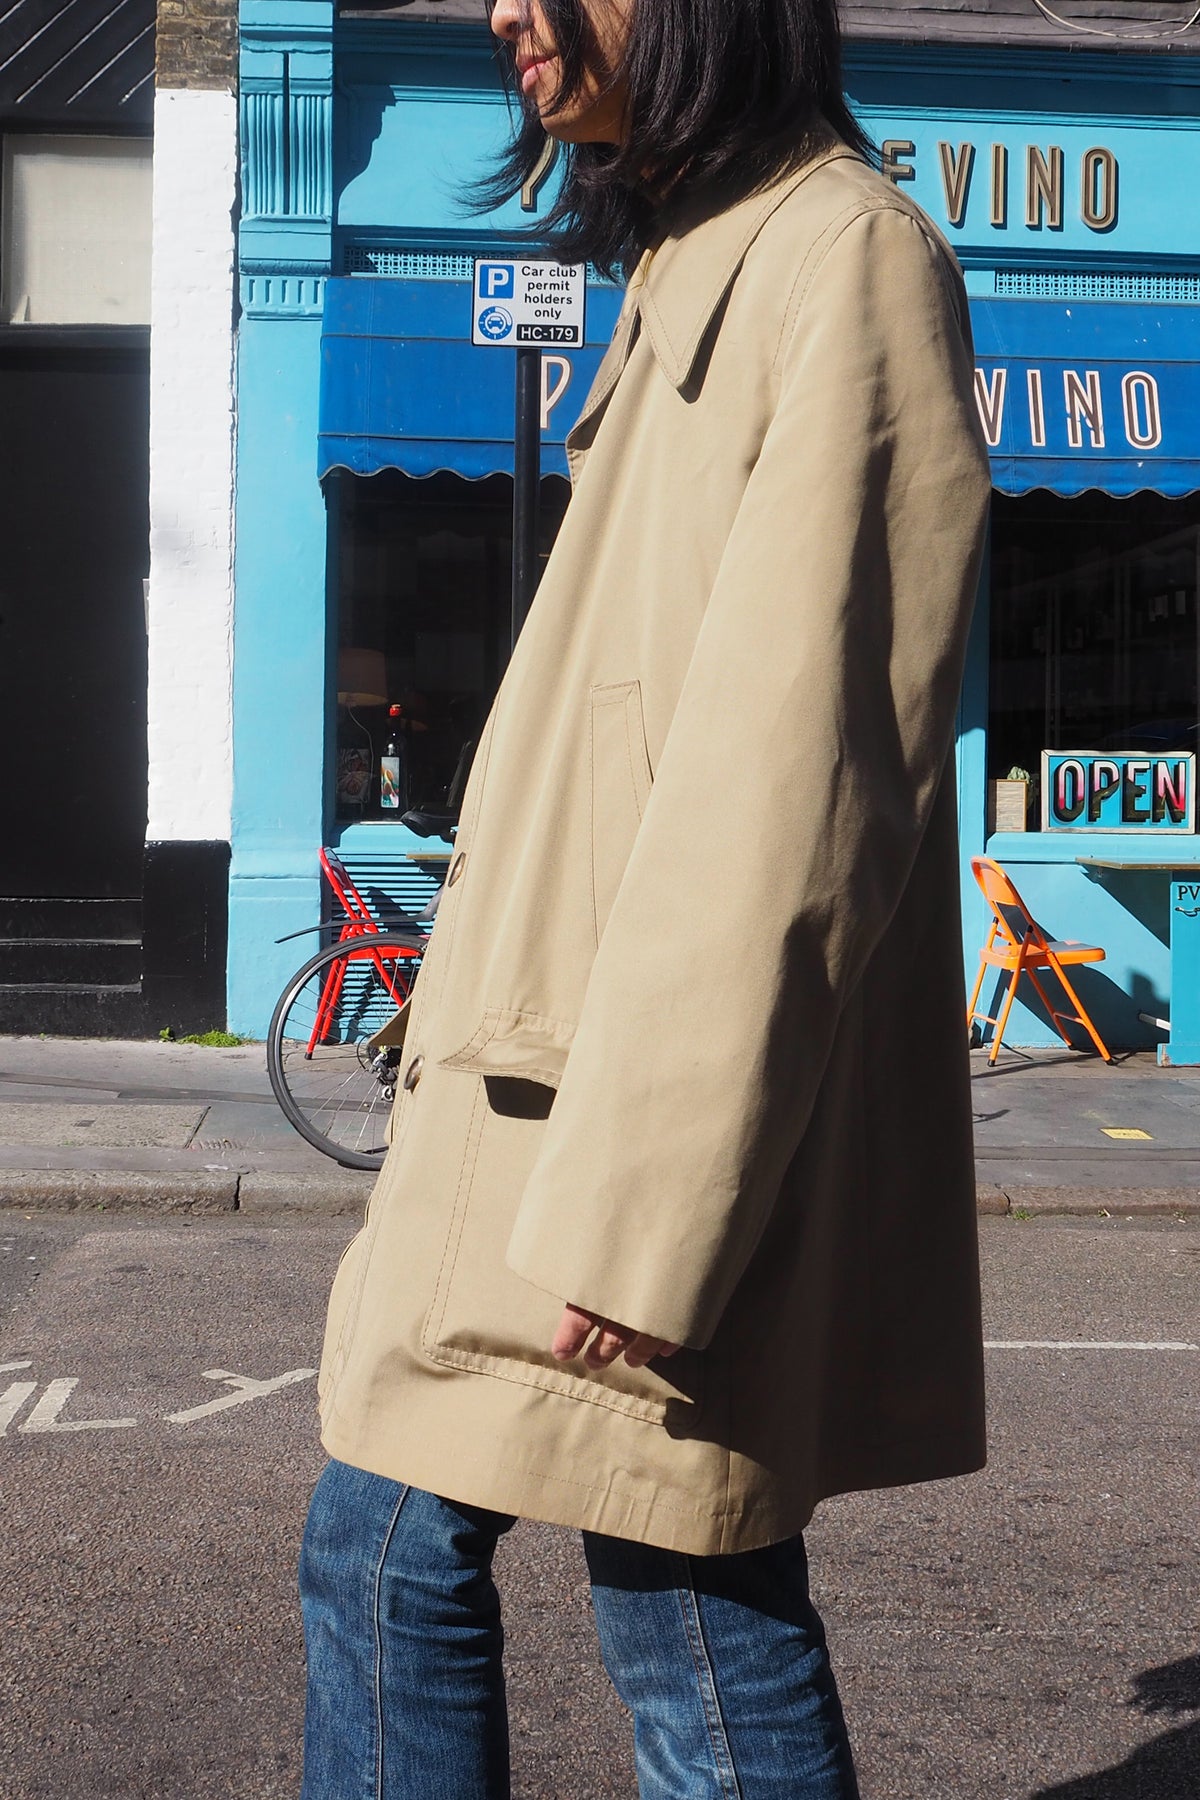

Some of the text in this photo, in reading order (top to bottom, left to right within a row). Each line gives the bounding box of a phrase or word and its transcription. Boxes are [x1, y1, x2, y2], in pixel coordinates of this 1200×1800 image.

[937, 140, 1117, 231] VINO
[521, 266, 577, 278] Car club
[487, 268, 509, 296] P
[527, 281, 570, 292] permit
[524, 293, 573, 305] holders
[534, 307, 562, 320] only
[521, 326, 574, 340] HC-179
[974, 368, 1162, 450] VINO
[1053, 758, 1187, 823] OPEN
